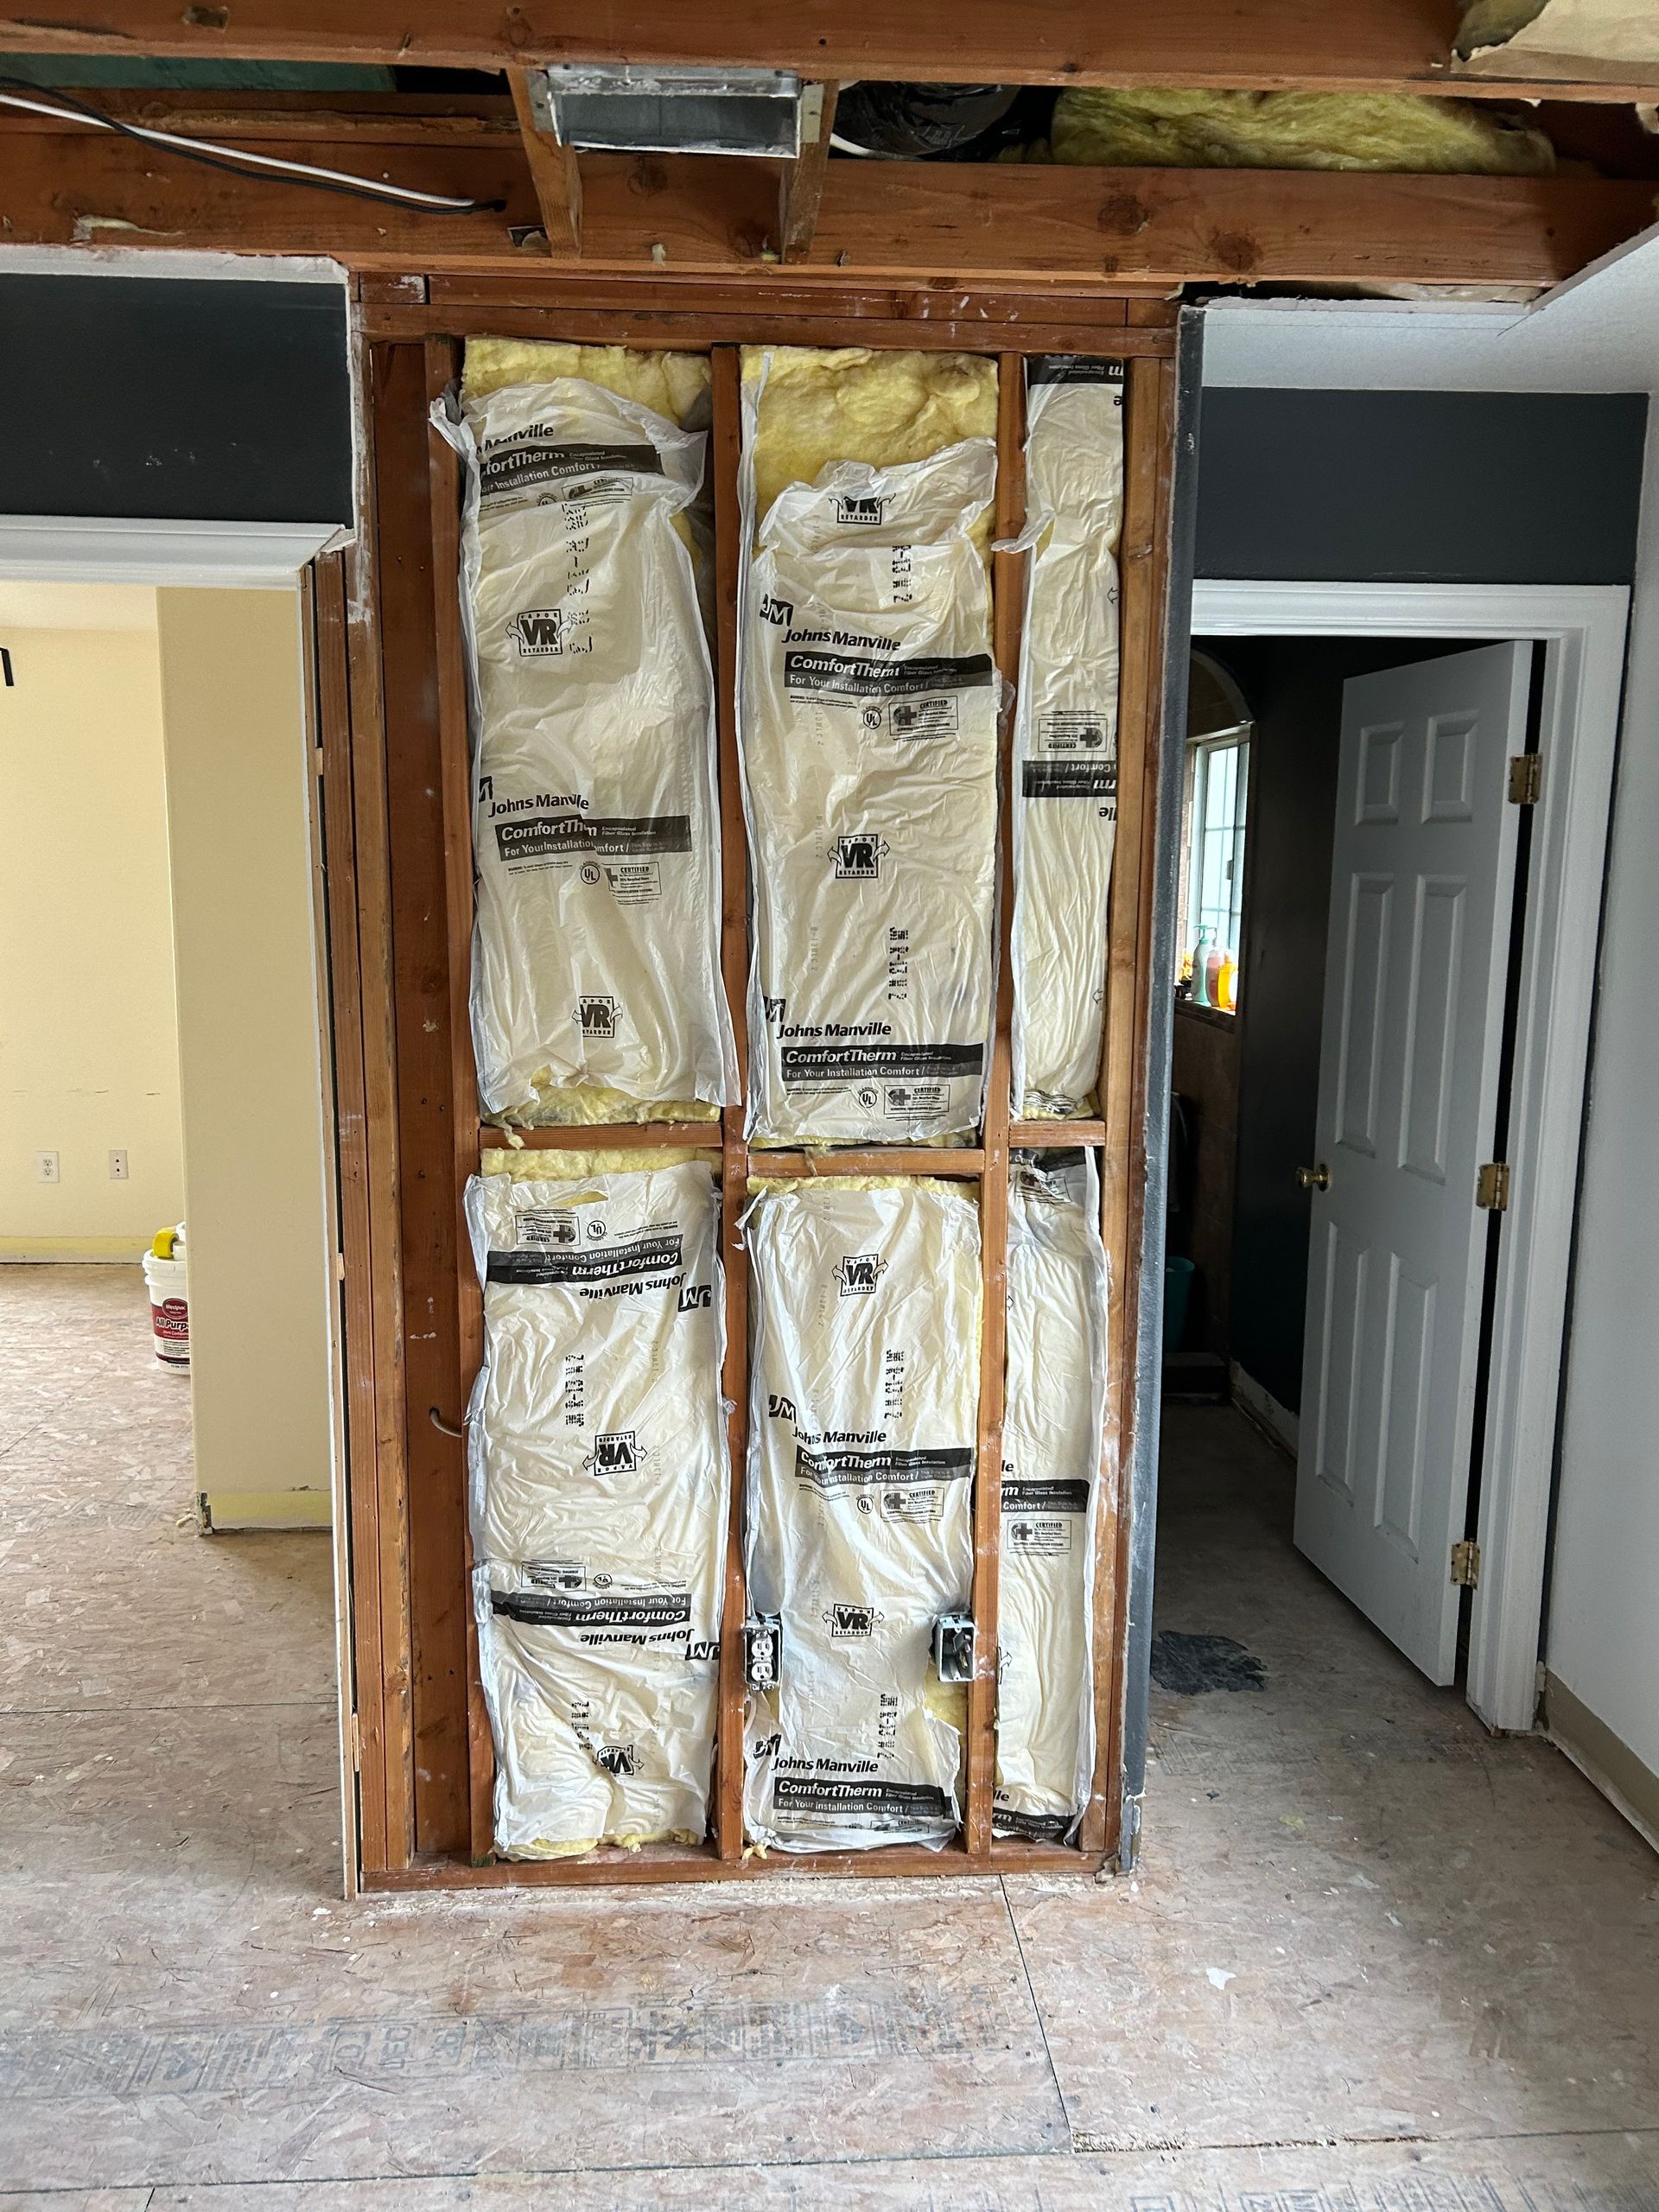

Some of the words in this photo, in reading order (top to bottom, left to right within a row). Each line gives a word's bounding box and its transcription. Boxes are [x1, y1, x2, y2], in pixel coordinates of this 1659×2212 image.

[496, 469, 550, 490] Installation
[520, 619, 558, 646] VR
[782, 629, 831, 644] Johns
[833, 632, 900, 652] Manville
[790, 655, 899, 678] ComfortTherm
[790, 675, 805, 684] For
[809, 676, 830, 688] Your
[832, 681, 881, 694] Installation
[884, 682, 924, 693] Comfort
[920, 700, 948, 709] CERTIFIED
[1071, 763, 1111, 772] Comfort
[488, 798, 534, 817] Johns
[505, 847, 518, 857] For
[522, 843, 543, 854] Your
[841, 843, 874, 868] VR
[581, 1004, 612, 1028] VR
[778, 1024, 823, 1039] Johns
[824, 1022, 892, 1037] Manville
[786, 1049, 897, 1064] ComfortTherm
[786, 1070, 801, 1078] For
[804, 1068, 824, 1078] Your
[828, 1067, 877, 1077] Installation
[880, 1066, 919, 1076] Comfort
[643, 1239, 663, 1249] Your
[665, 1237, 679, 1248] For
[548, 1255, 587, 1263] Comfort
[589, 1243, 641, 1260] Installation
[572, 1250, 678, 1276] ComfortTherm
[645, 1272, 686, 1291] Johns
[846, 1262, 875, 1286] VR
[579, 1282, 643, 1301] Manville
[678, 1285, 712, 1312] JM
[156, 1317, 164, 1327] All
[165, 1319, 188, 1332] Purp
[769, 1395, 797, 1423] JM
[823, 1431, 887, 1444] Manville
[598, 1442, 633, 1467] VR
[800, 1452, 892, 1472] ComfortTherm
[598, 1464, 632, 1472] VAPOR
[800, 1466, 812, 1478] For
[814, 1473, 828, 1484] Your
[828, 1473, 873, 1484] Installation
[876, 1471, 914, 1481] Comfort
[1002, 1502, 1040, 1510] Comfort
[553, 1599, 591, 1609] Comfort
[594, 1598, 646, 1607] Installation
[648, 1597, 669, 1605] Your
[672, 1597, 686, 1605] For
[575, 1609, 686, 1623] ComfortTherm
[836, 1611, 868, 1630] VR
[581, 1633, 646, 1645] Manville
[649, 1628, 695, 1642] Johns
[685, 1642, 720, 1661] JM
[772, 1758, 814, 1771] Johns
[816, 1758, 878, 1772] Manville
[779, 1780, 882, 1797] ComfortTherm
[795, 1799, 814, 1808] Your
[816, 1800, 864, 1812] Installation
[866, 1802, 904, 1813] Comfort
